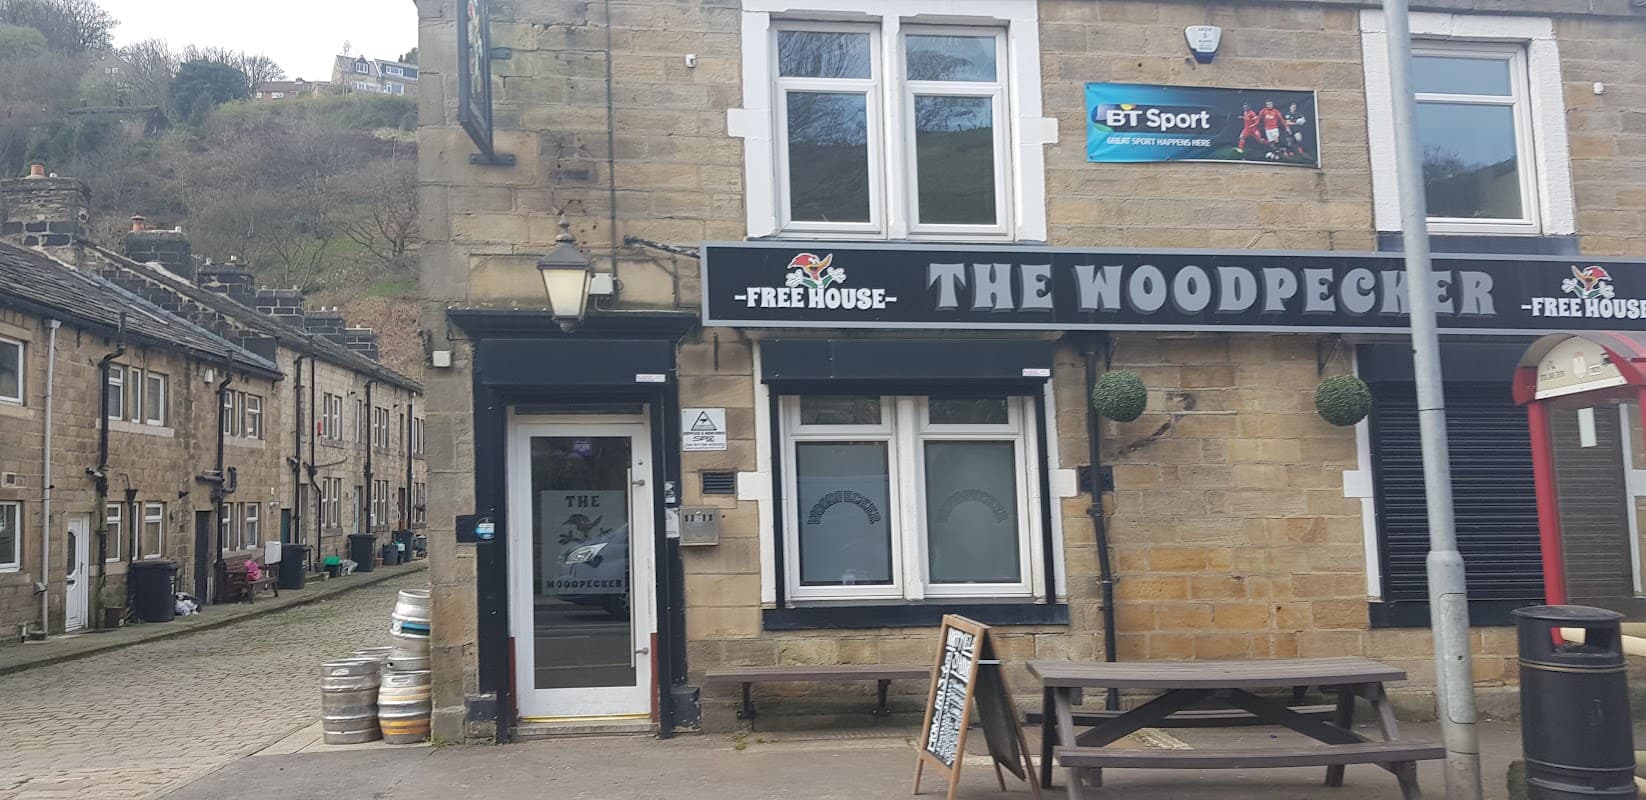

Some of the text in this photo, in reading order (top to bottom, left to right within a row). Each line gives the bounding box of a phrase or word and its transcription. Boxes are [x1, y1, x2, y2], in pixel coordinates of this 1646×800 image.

[1106, 107, 1210, 131] BT Sport
[1106, 136, 1211, 147] GREAT SPORT HAPPENS HERE
[926, 263, 1497, 316] THE WOODPECKER
[565, 495, 601, 508] THE
[546, 579, 622, 588] WOODPECKER
